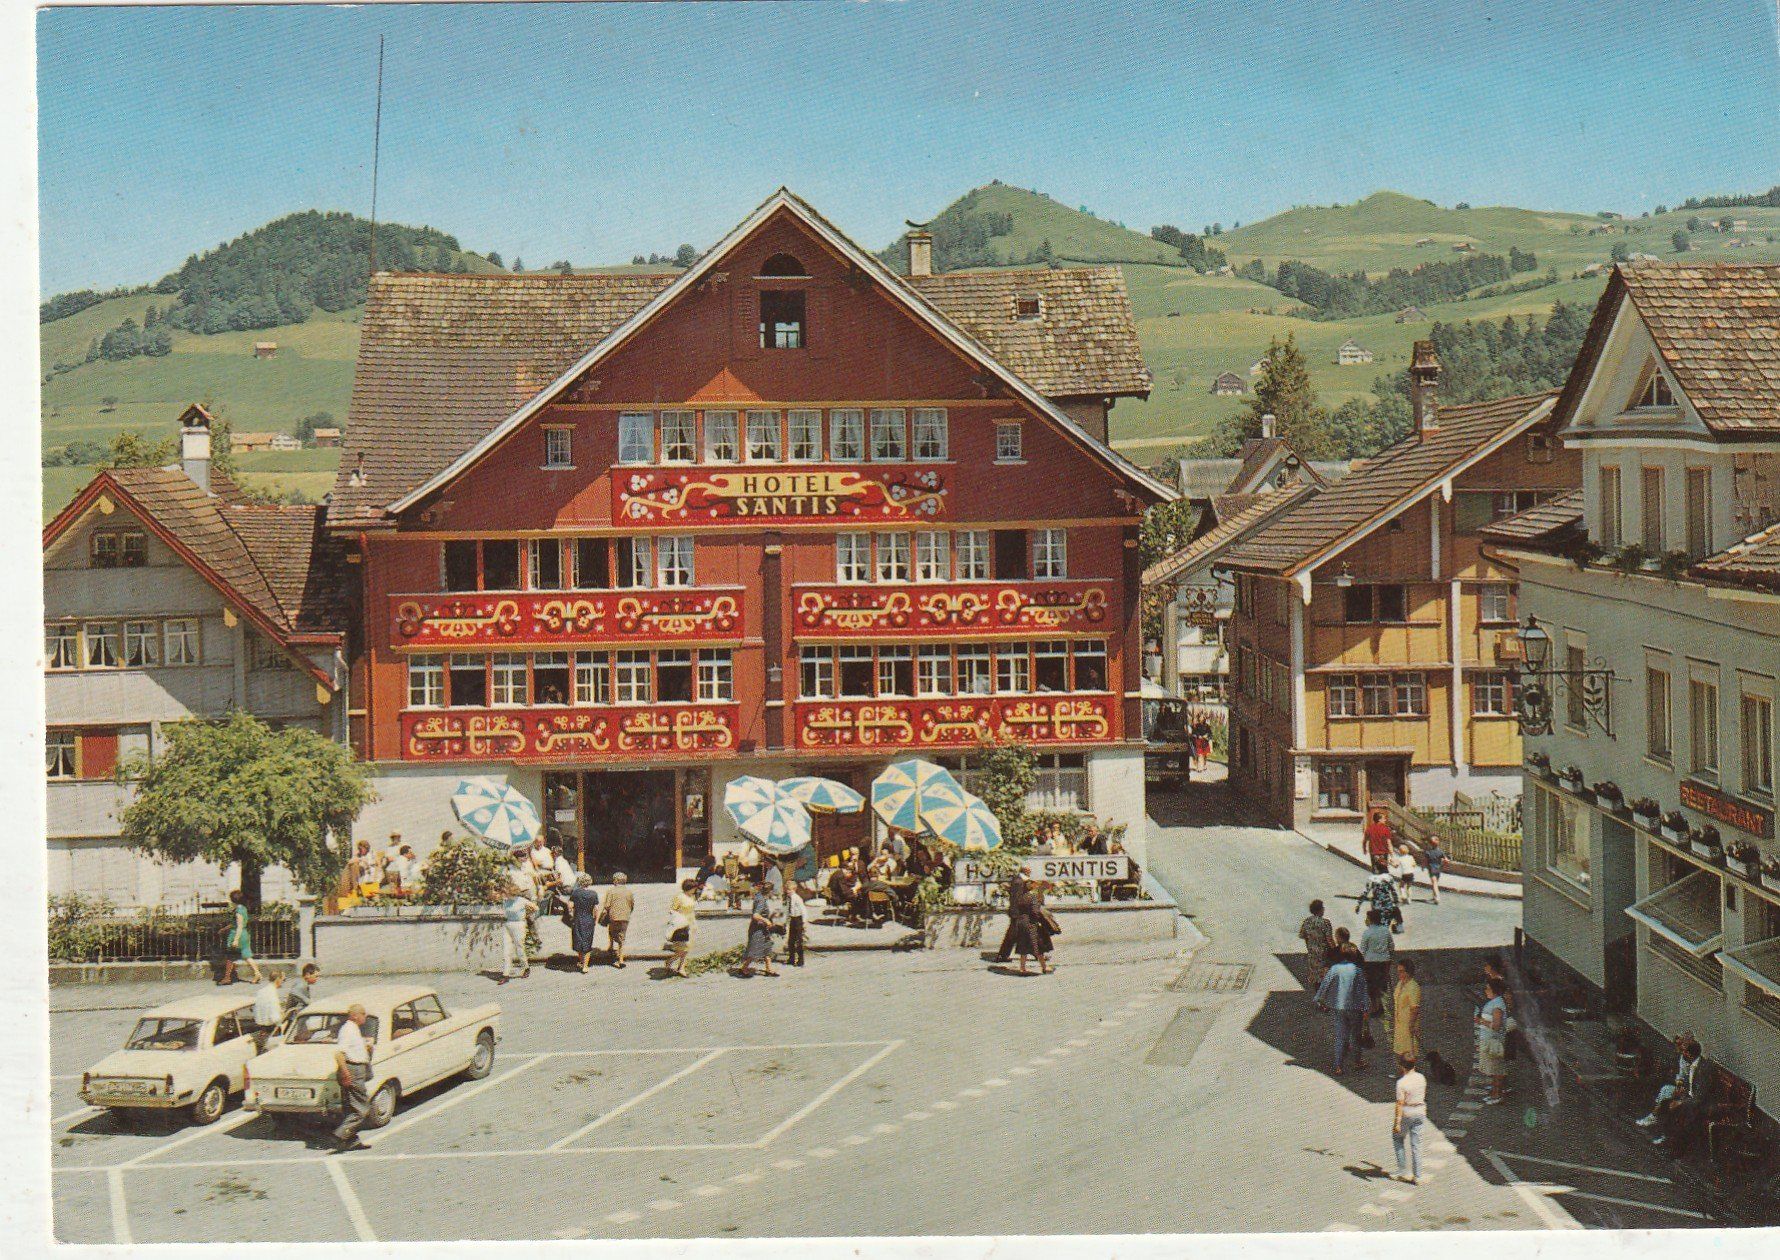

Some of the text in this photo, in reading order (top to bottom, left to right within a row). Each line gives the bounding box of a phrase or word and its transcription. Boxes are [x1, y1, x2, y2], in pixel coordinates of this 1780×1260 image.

[743, 475, 834, 493] HOTEL
[736, 496, 838, 515] SÄNTIS
[1044, 860, 1118, 878] SÄNTIS
